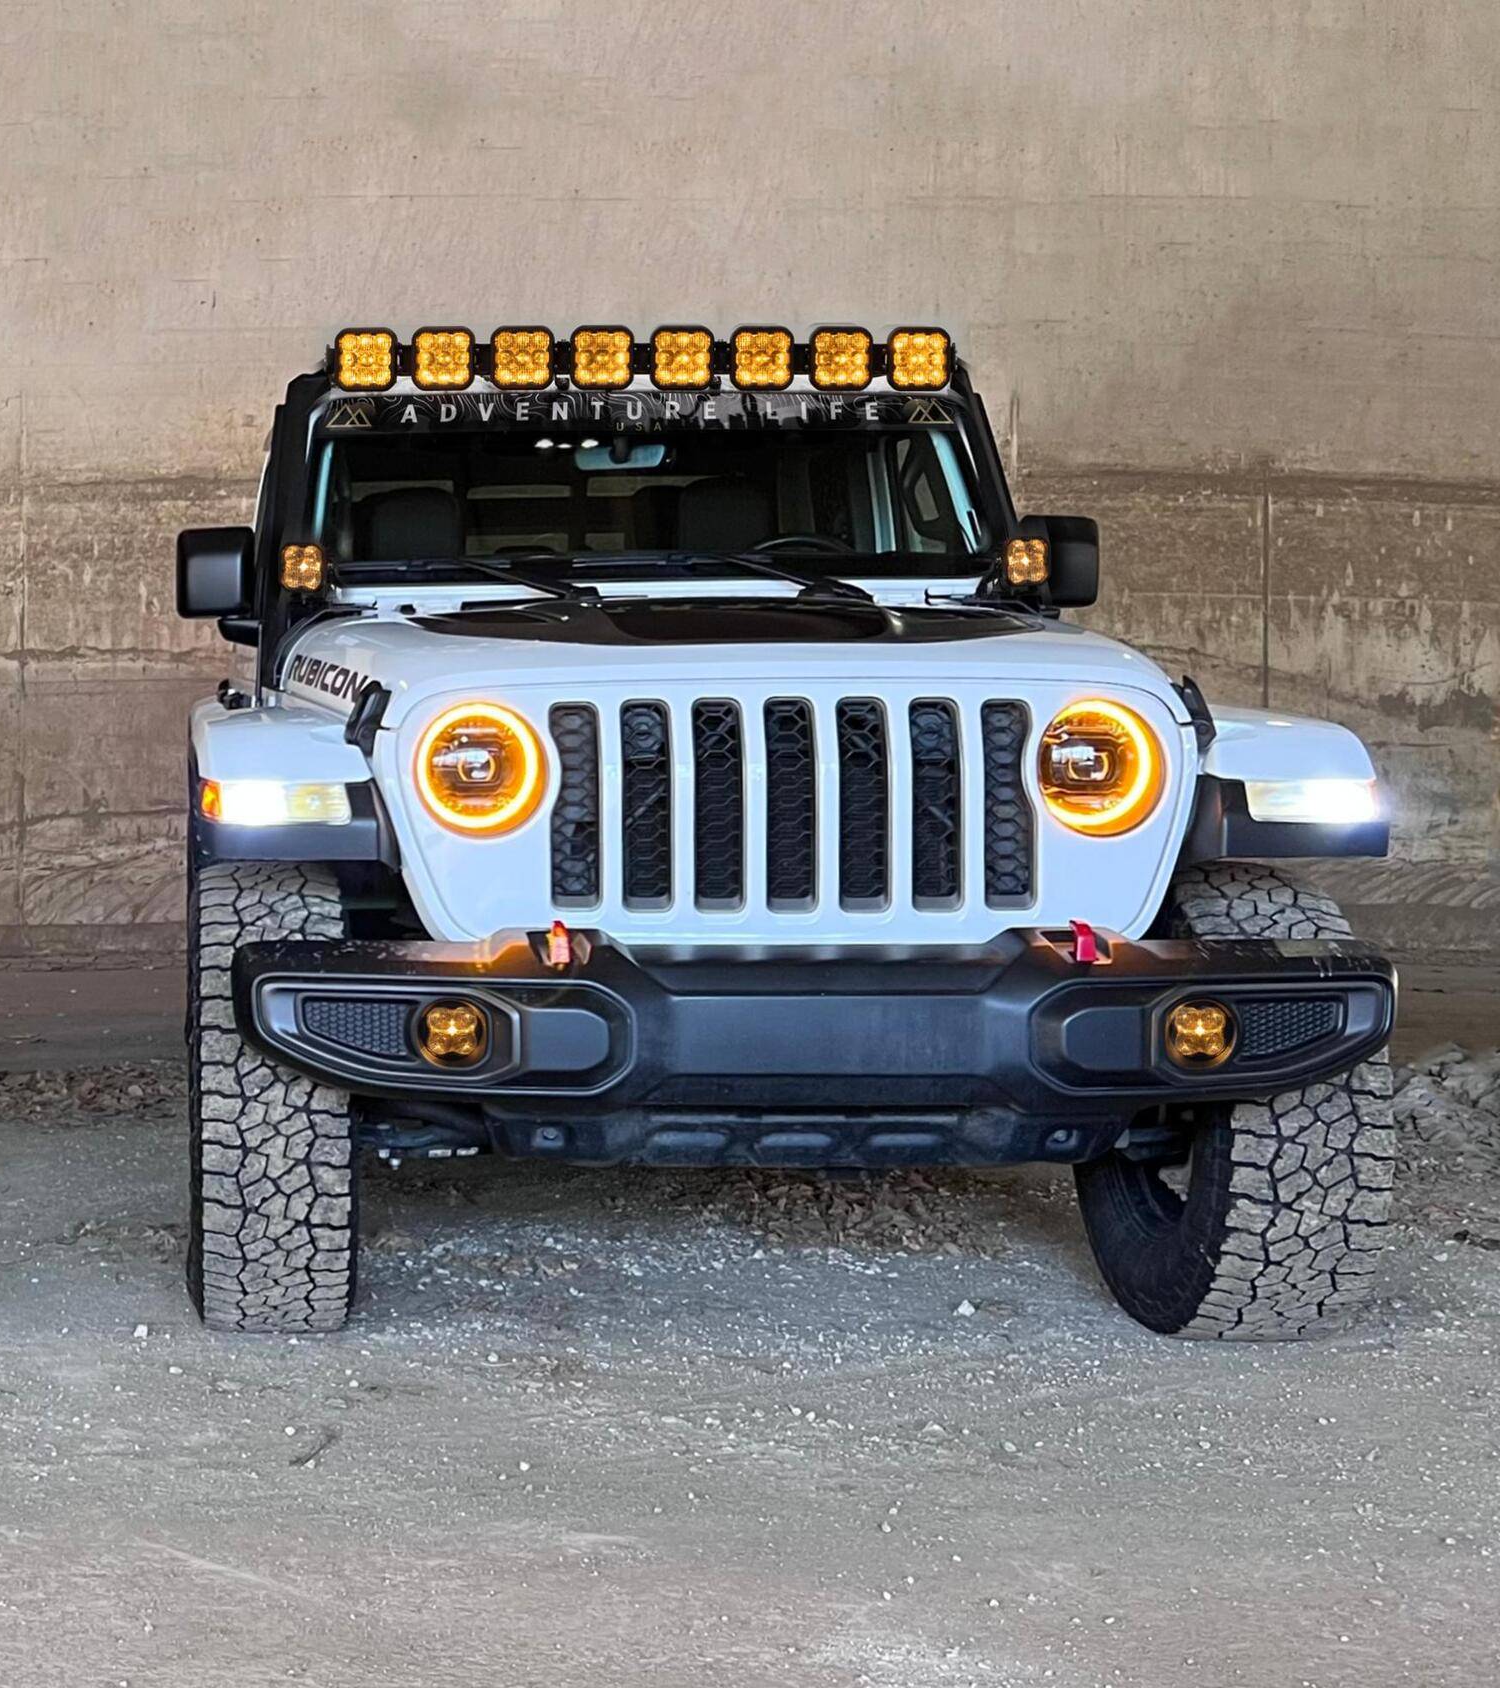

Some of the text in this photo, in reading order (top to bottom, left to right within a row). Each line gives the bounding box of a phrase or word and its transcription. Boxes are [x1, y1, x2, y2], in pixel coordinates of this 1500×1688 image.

[400, 401, 880, 424] ADVENTURE LIFE
[288, 655, 369, 703] RUBICON
